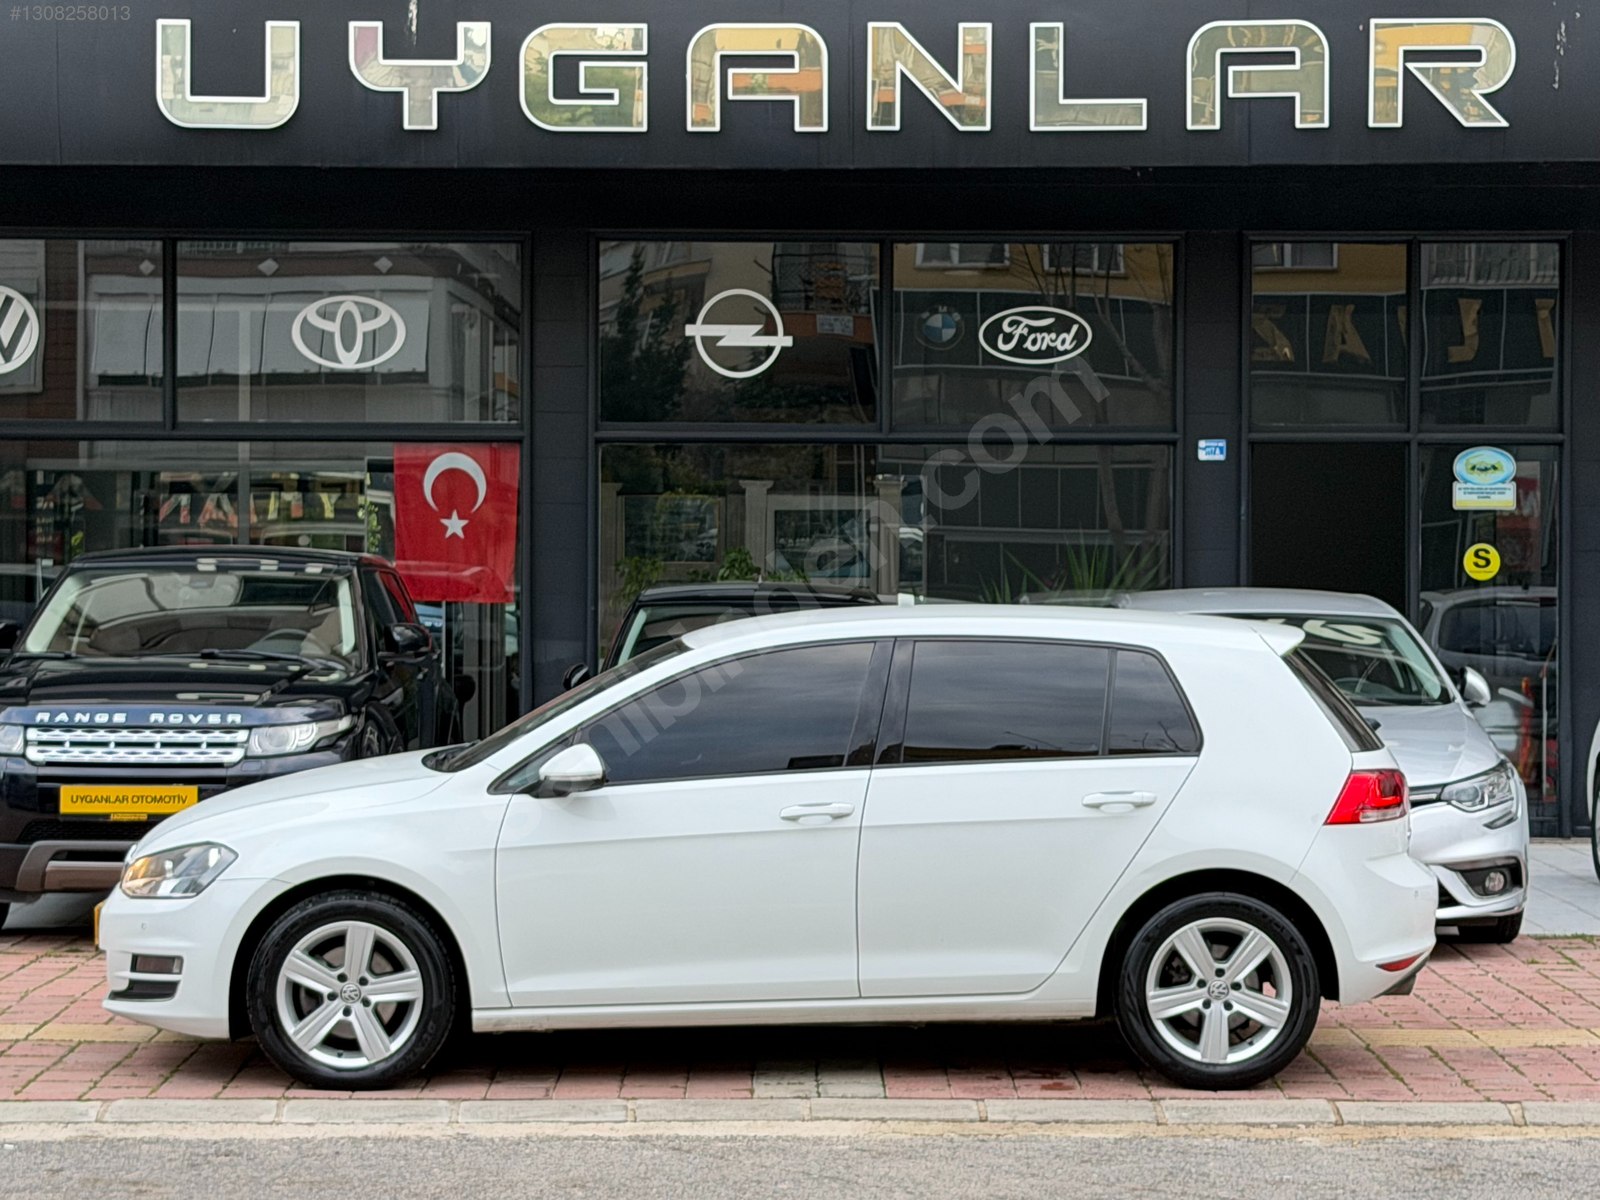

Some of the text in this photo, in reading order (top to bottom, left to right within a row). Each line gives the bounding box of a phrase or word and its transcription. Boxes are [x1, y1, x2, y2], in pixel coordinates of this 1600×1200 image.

[155, 16, 1518, 133] UYGANLAR
[997, 315, 1080, 352] Ford
[1472, 548, 1491, 568] S
[35, 712, 242, 725] RANGE ROVER
[70, 792, 188, 804] UYGANLAR OTOMOTİV
